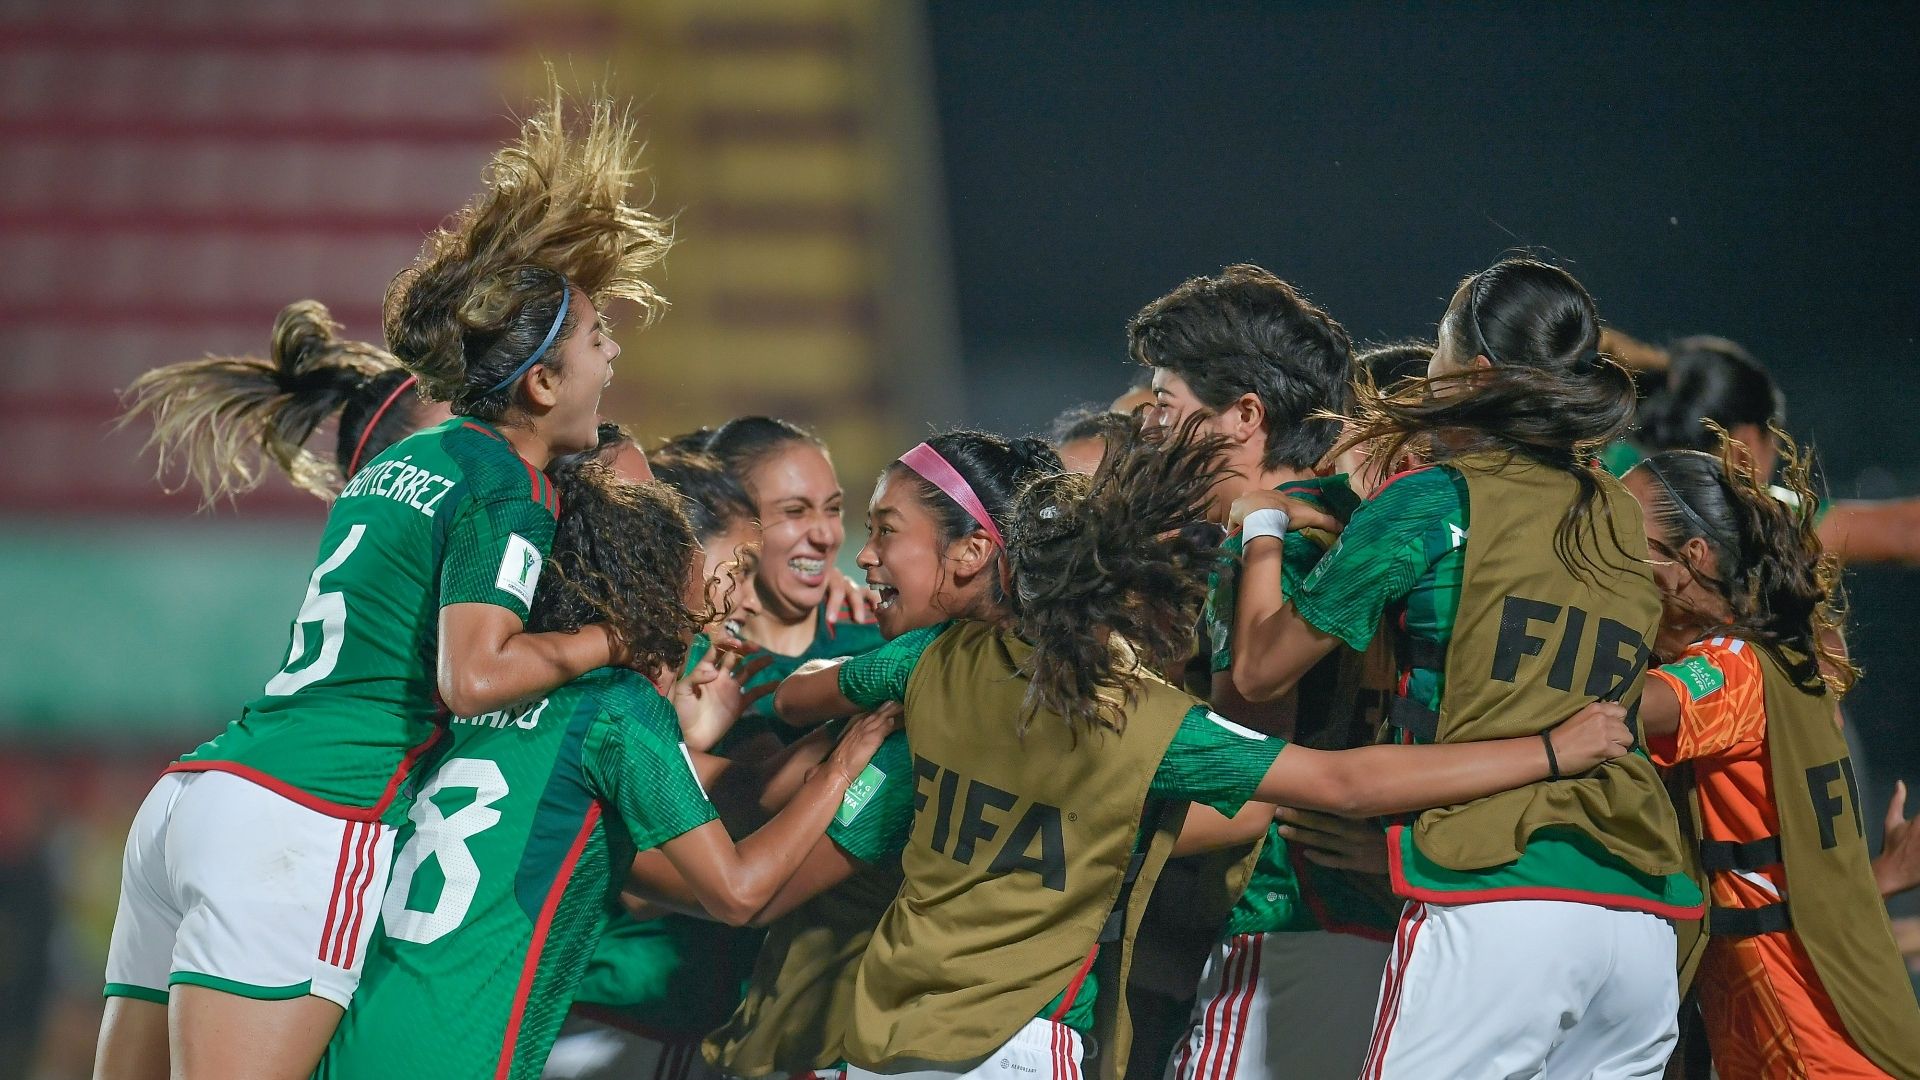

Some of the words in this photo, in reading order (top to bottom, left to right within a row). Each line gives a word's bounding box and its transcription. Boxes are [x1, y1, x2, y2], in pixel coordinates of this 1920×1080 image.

[341, 455, 456, 518] GUTIÉRREZ
[264, 524, 367, 696] 6
[1490, 595, 1651, 702] FIF
[381, 757, 510, 945] 8
[912, 753, 1067, 892] FIFA
